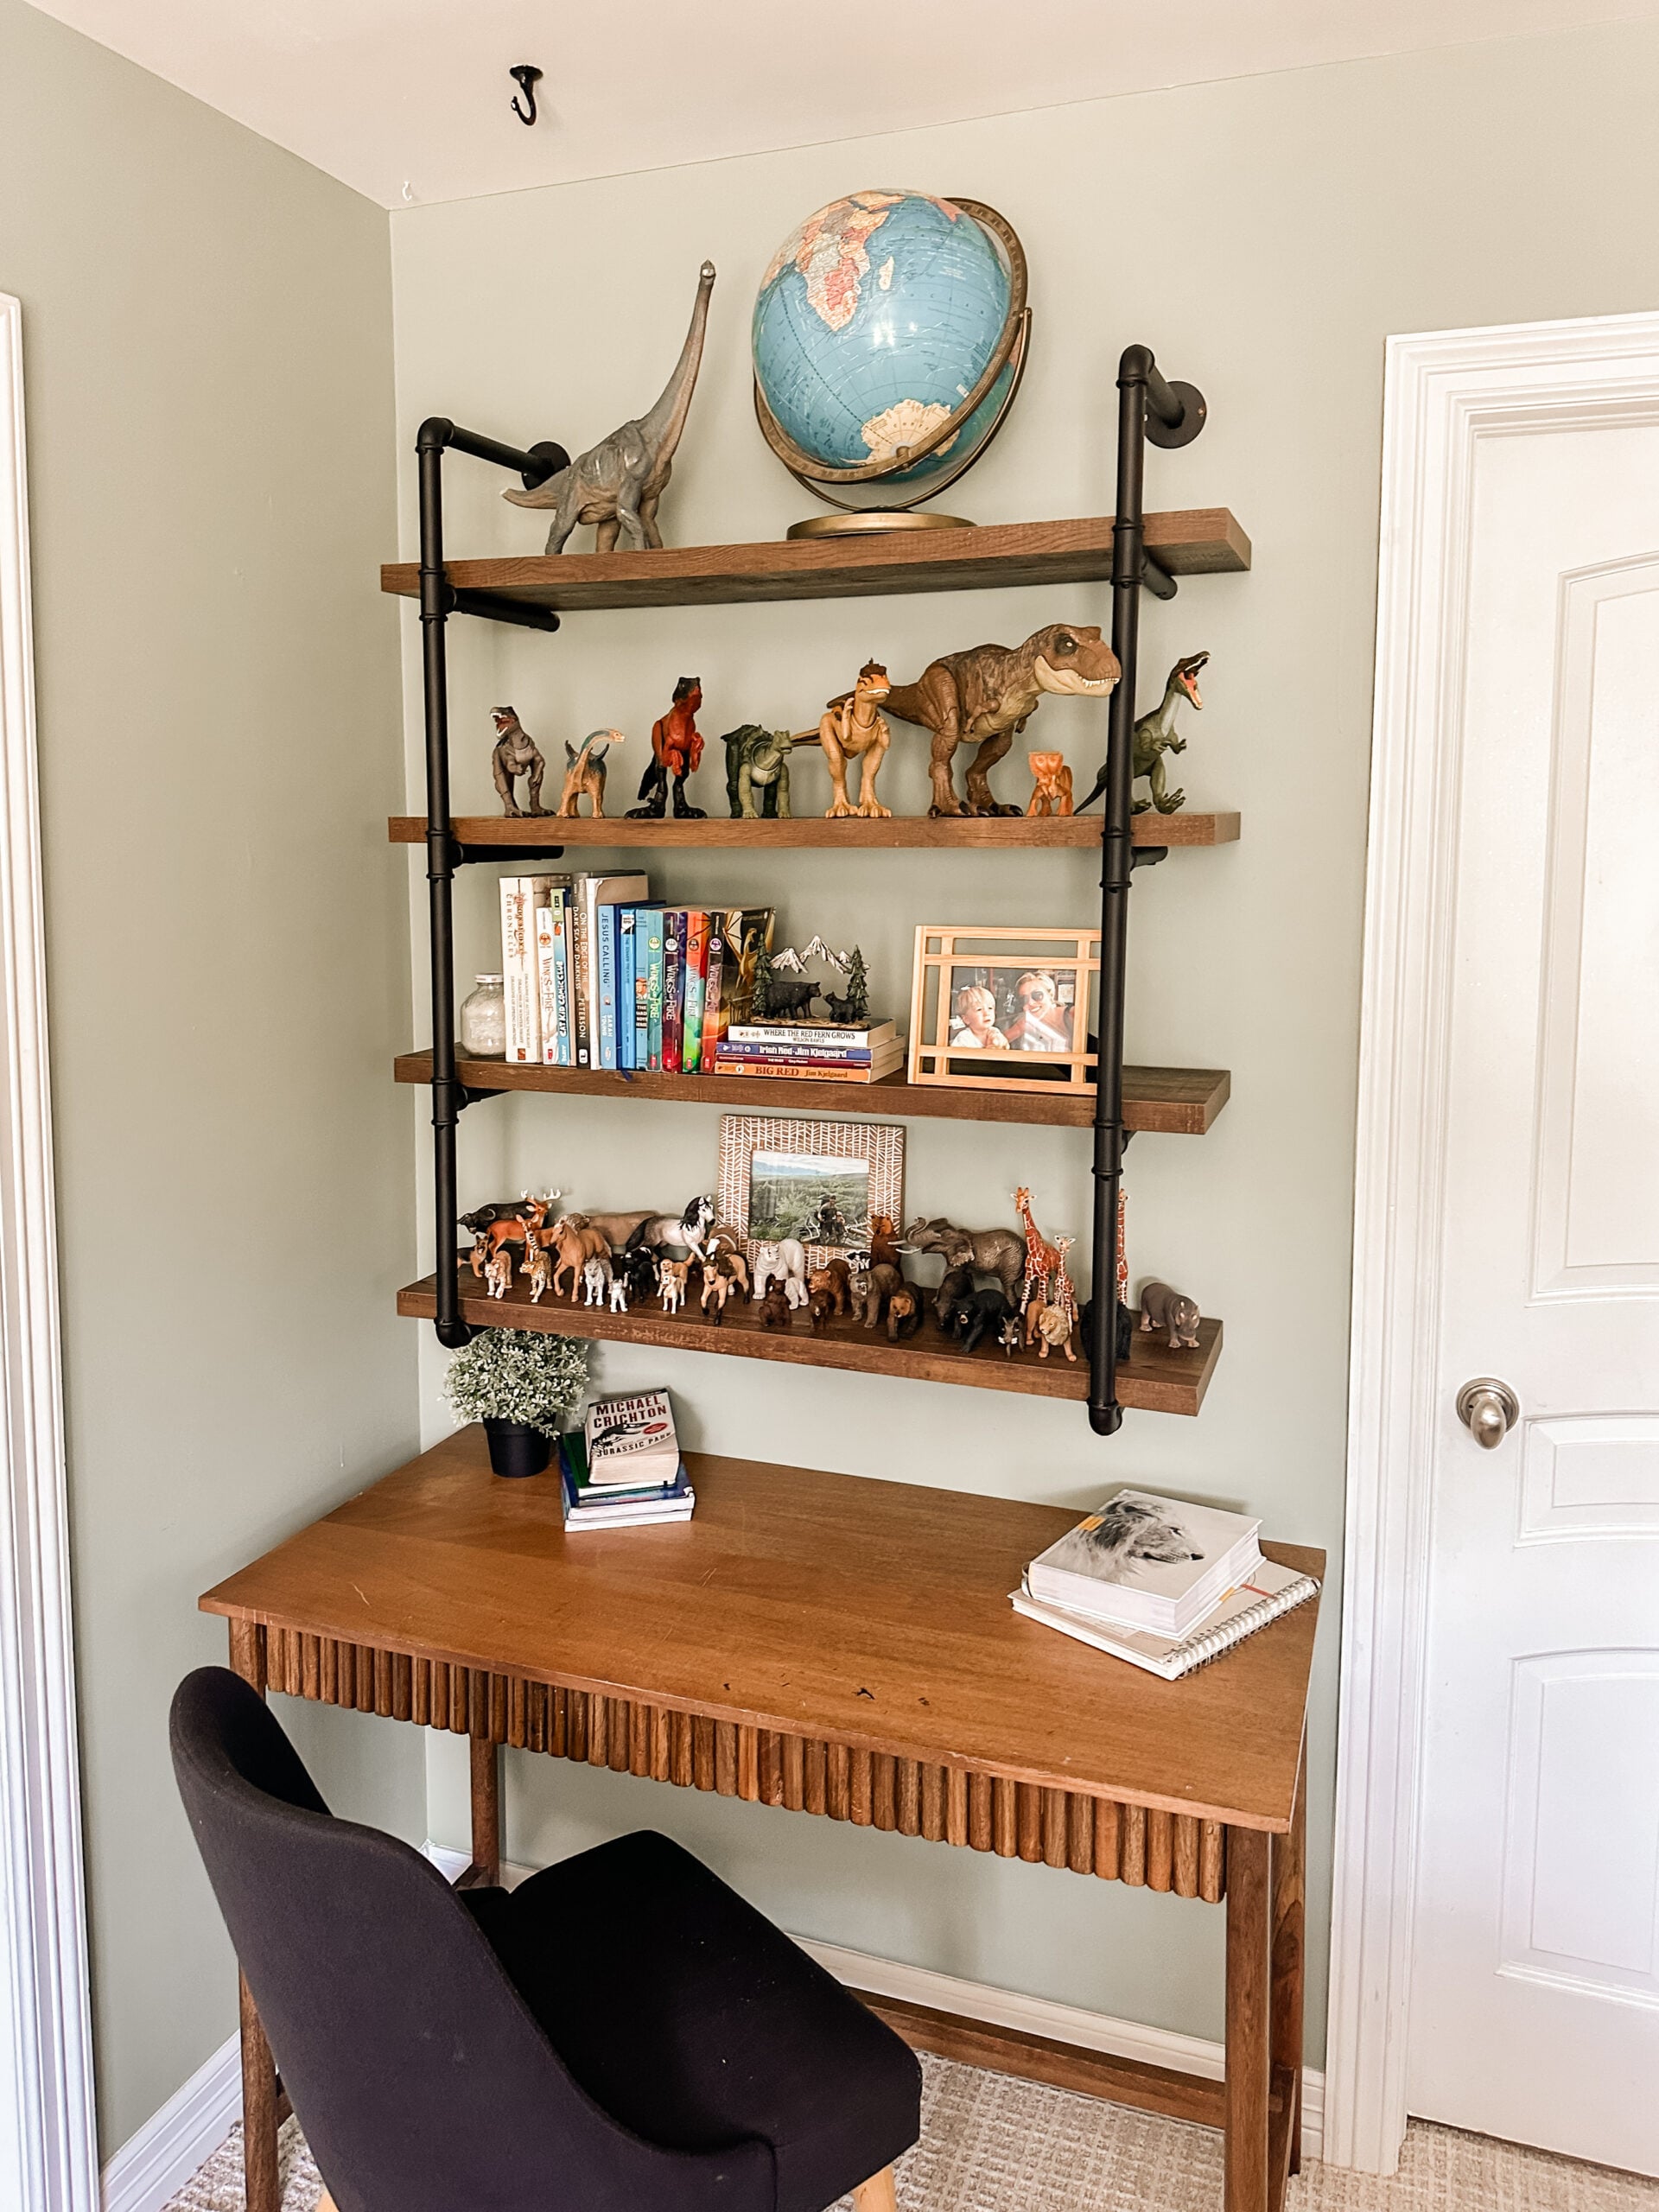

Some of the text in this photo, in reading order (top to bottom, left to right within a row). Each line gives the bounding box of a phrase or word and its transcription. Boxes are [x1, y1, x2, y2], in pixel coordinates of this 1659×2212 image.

[579, 912, 587, 925] ON
[575, 944, 580, 952] OF
[543, 957, 552, 986] WINGS
[556, 960, 565, 982] CLUB
[582, 961, 588, 970] OF
[649, 959, 662, 992] WINGS
[666, 963, 678, 994] WINGS
[689, 964, 698, 993] WINGS
[543, 993, 554, 1011] FIRE
[649, 997, 662, 1019] FIRE
[666, 1000, 677, 1020] FIRE
[688, 1000, 697, 1017] FIRE
[578, 997, 587, 1038] PETERSON
[558, 1020, 567, 1037] CAT
[760, 1046, 777, 1054] Irish
[795, 1046, 810, 1056] Jim
[810, 1048, 848, 1058] Kjelgaard
[755, 1066, 799, 1077] BIG RED
[596, 1395, 661, 1415] MICHAEL
[594, 1405, 667, 1428] CRICHTON
[596, 1441, 645, 1458] JURASSIC
